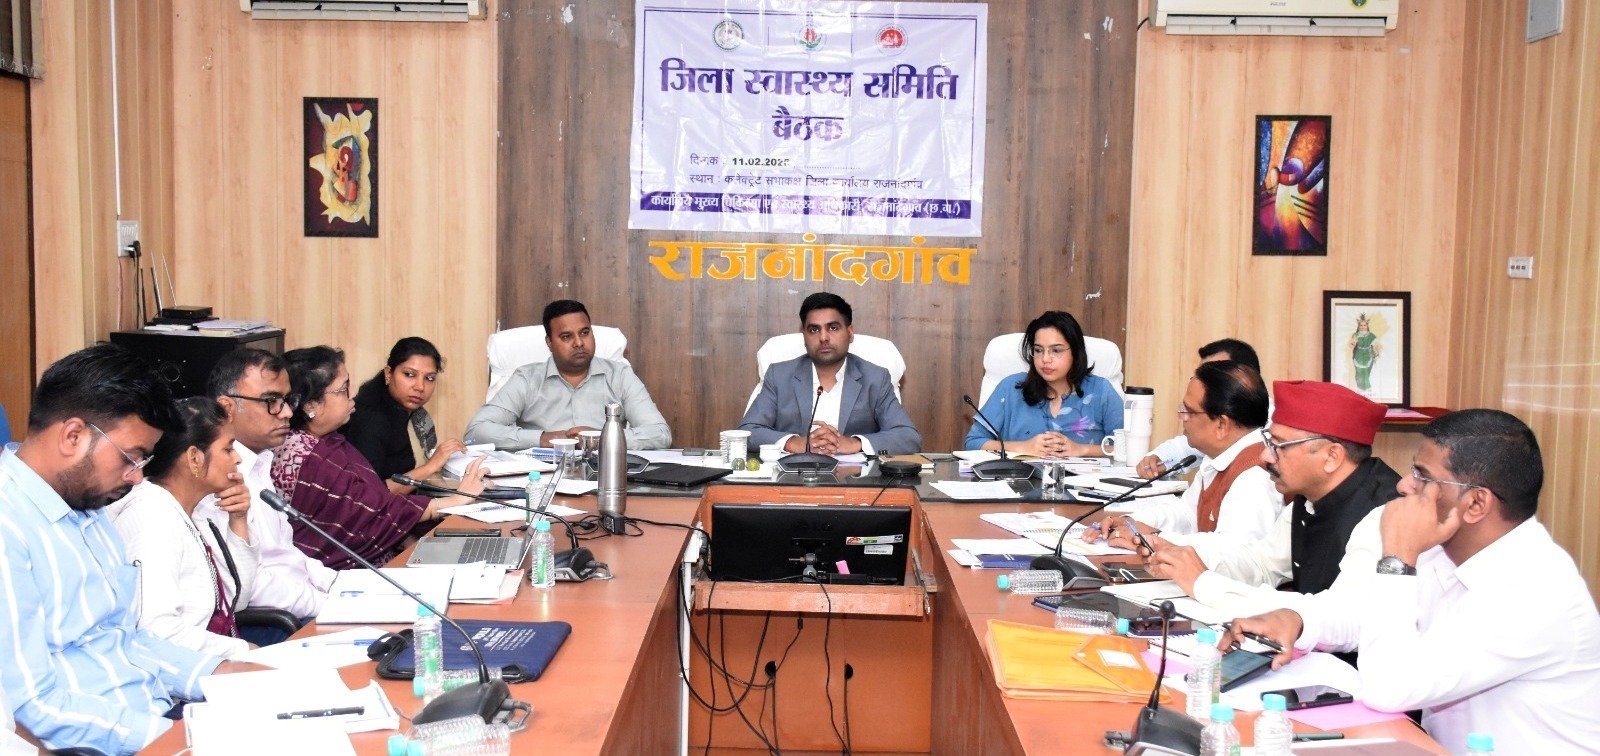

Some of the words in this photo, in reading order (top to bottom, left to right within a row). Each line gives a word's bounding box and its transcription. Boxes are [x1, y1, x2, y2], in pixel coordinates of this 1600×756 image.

[660, 58, 734, 94] जिला
[744, 69, 853, 98] स्वास्थ्य
[863, 64, 959, 100] समिति
[772, 106, 844, 141] बैठक
[649, 233, 977, 286] राजनांदगांव
